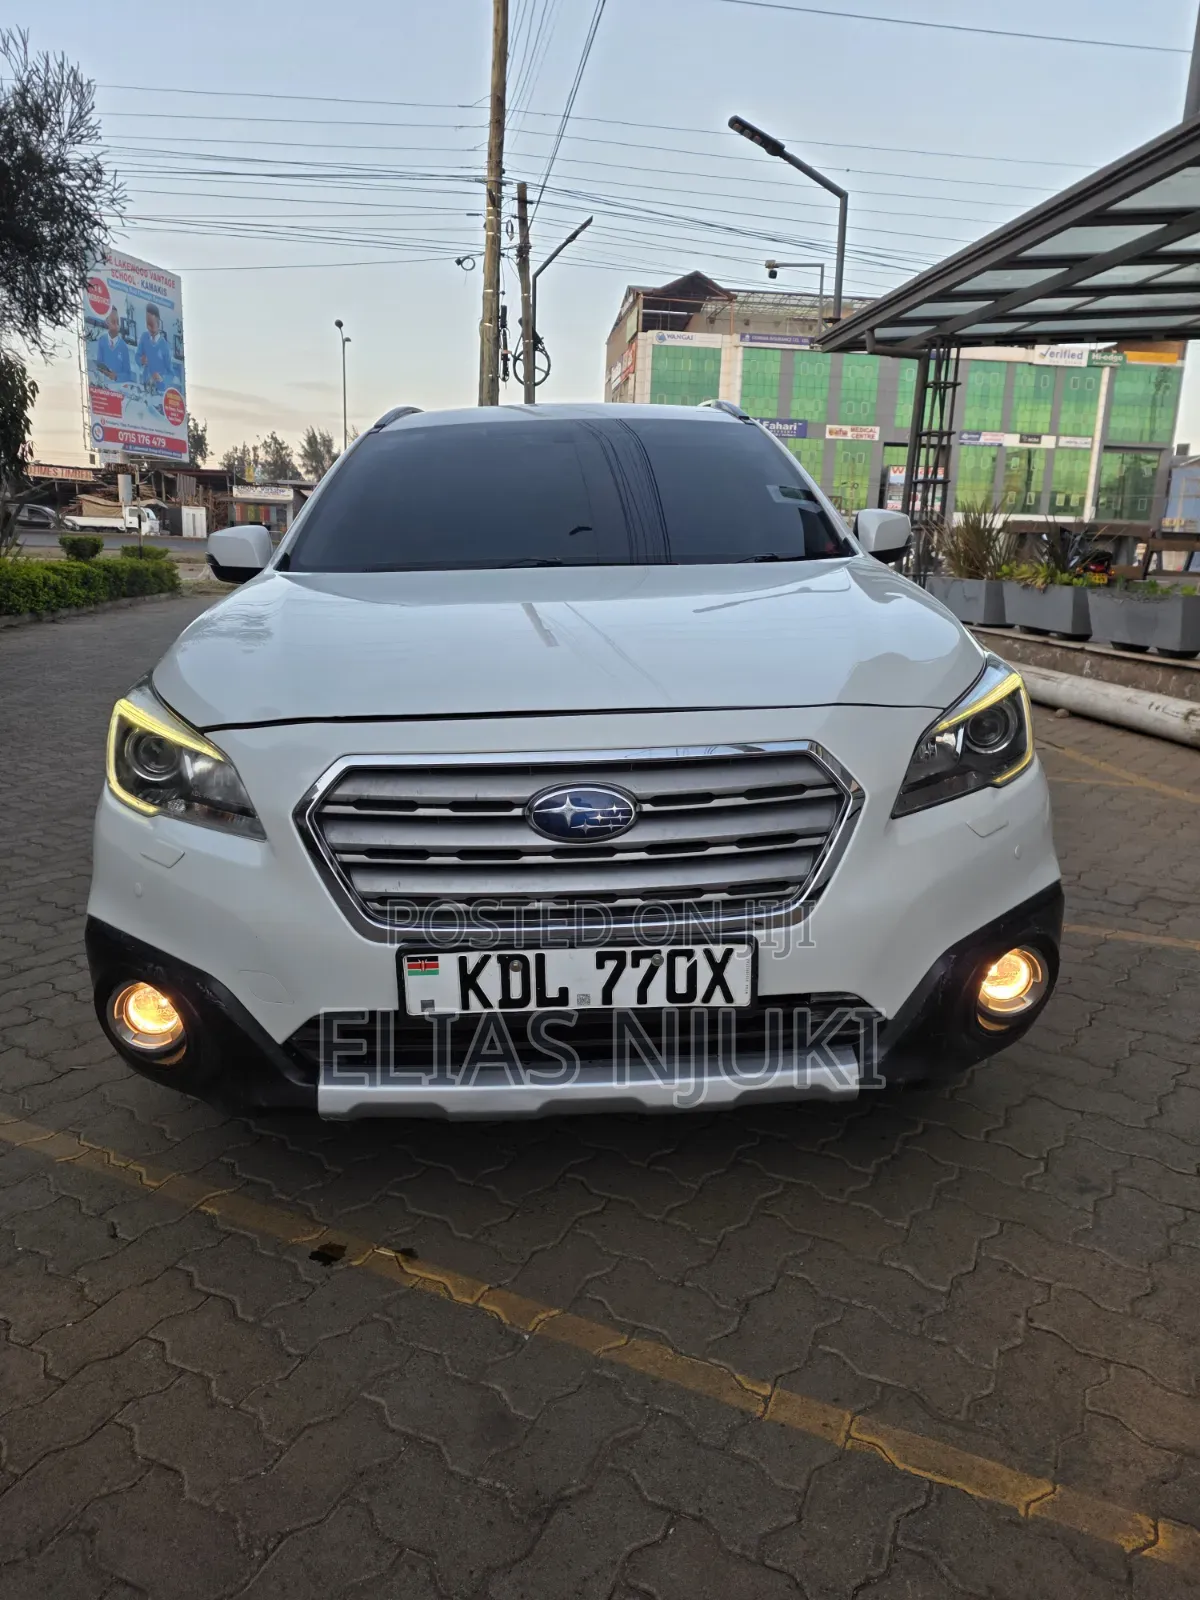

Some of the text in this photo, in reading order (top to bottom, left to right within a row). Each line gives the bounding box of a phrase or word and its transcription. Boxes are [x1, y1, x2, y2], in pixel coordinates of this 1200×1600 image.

[111, 268, 137, 286] SCHOOL
[140, 279, 168, 297] KAMAKIS
[149, 270, 176, 289] VANTAGE
[762, 420, 797, 431] Fahari
[118, 430, 167, 448] 0715 176 479
[458, 952, 569, 1010] KDL
[595, 946, 736, 1005] 770X
